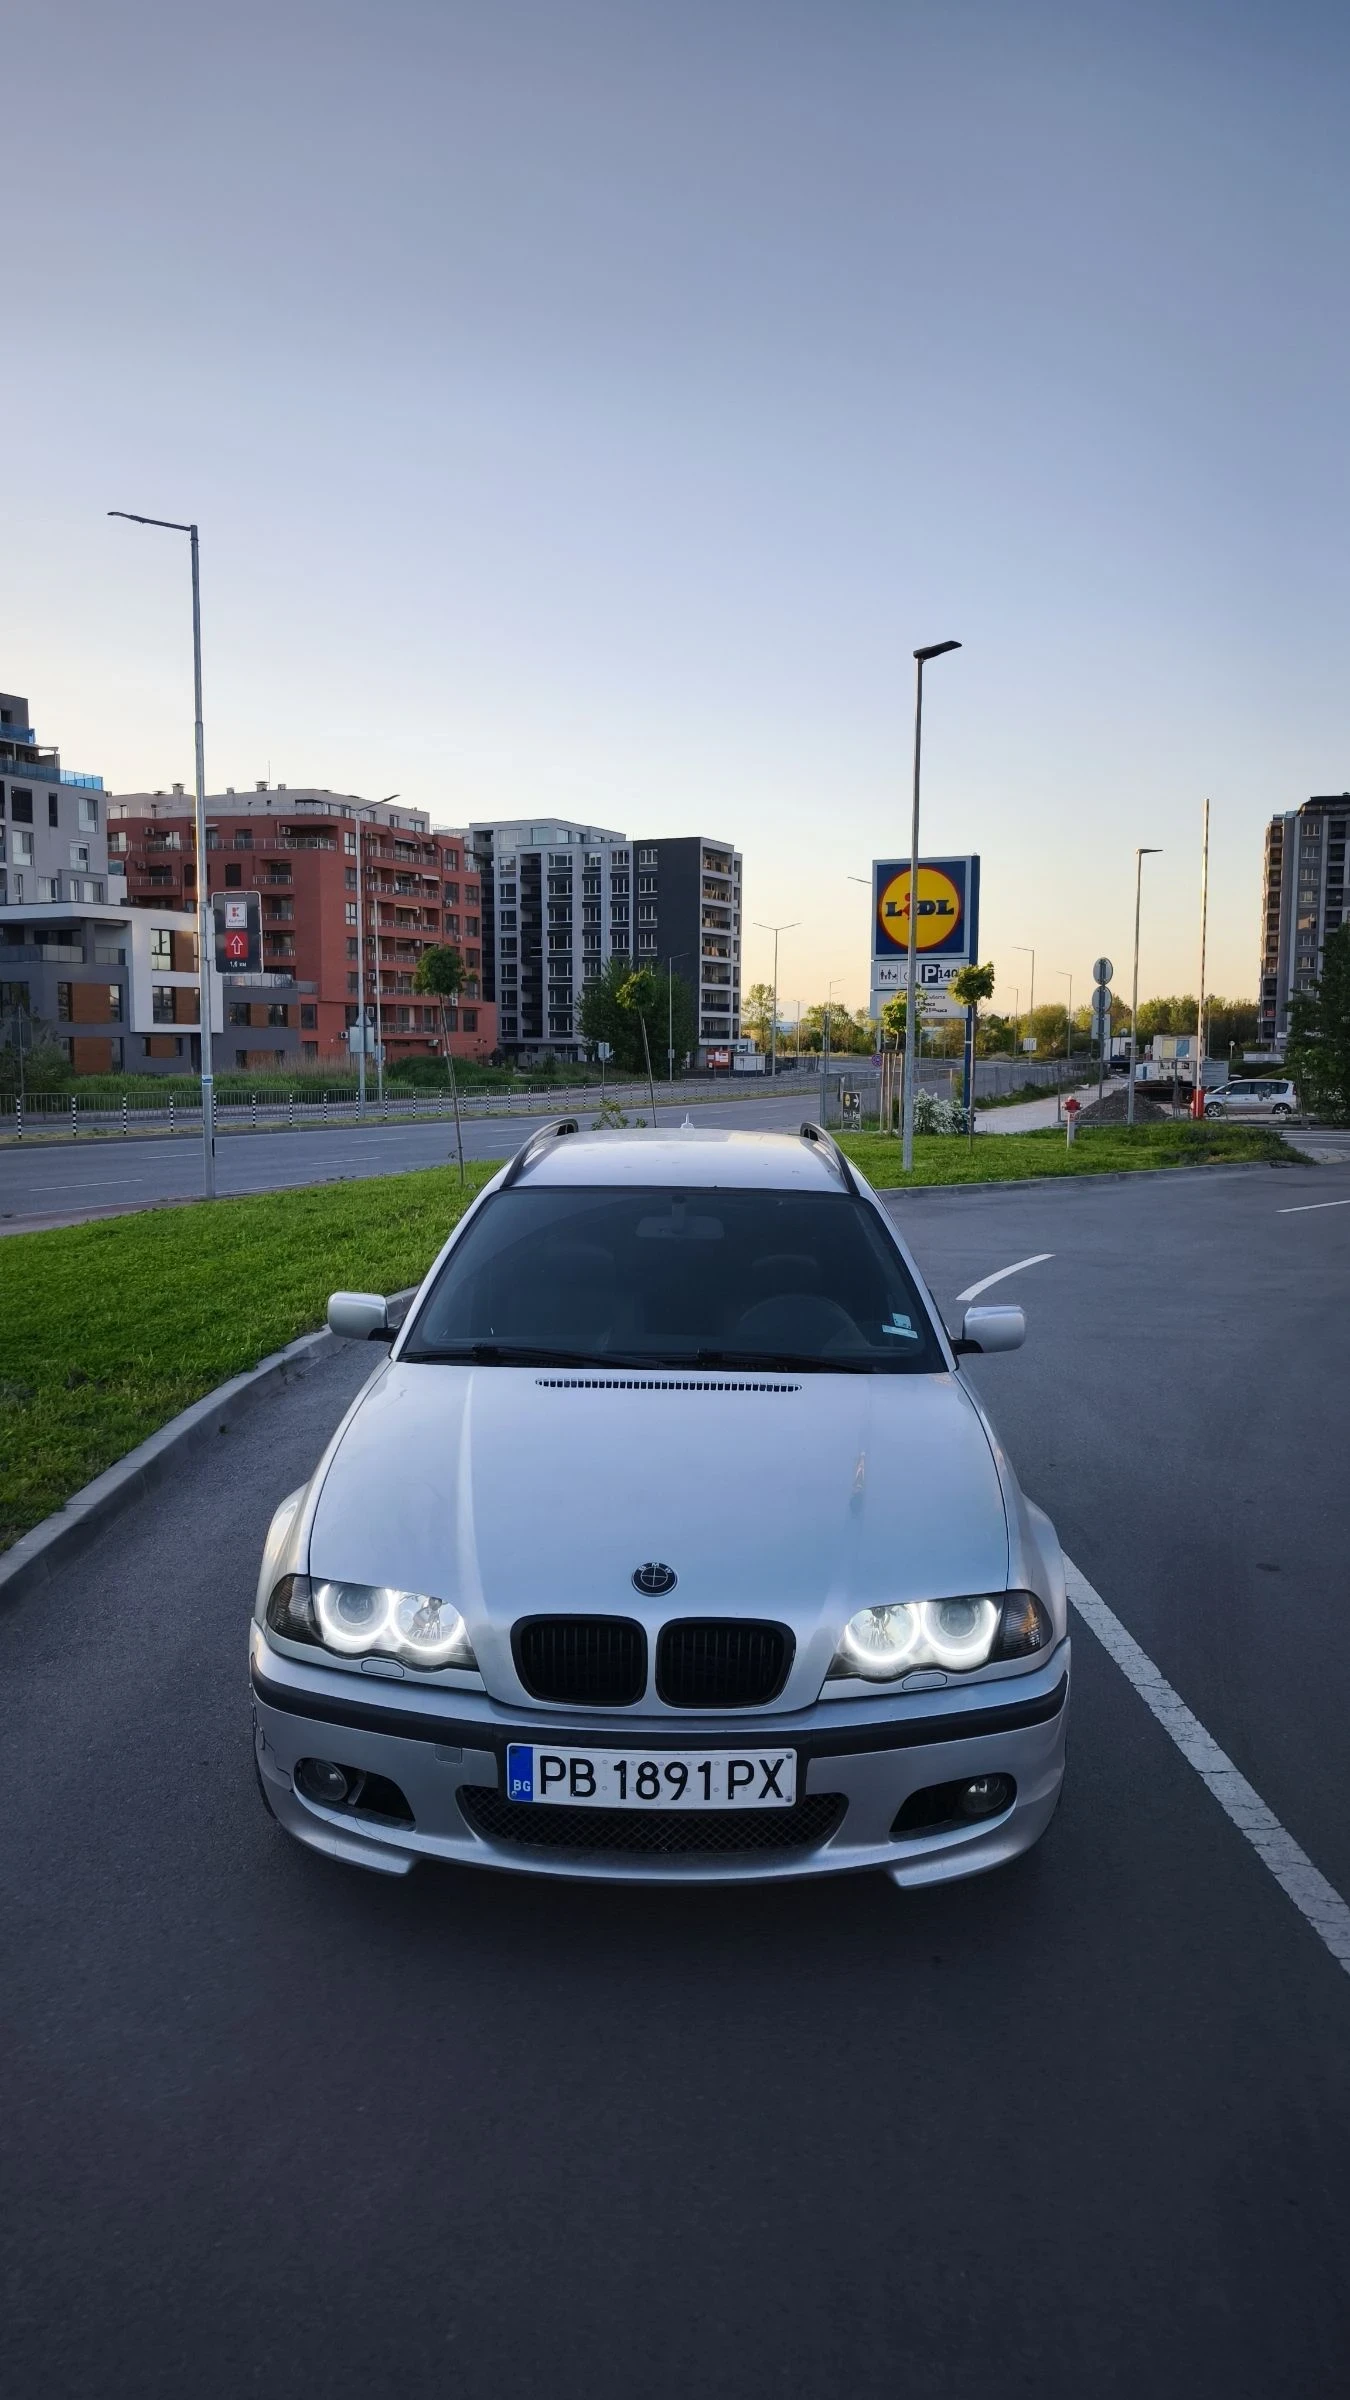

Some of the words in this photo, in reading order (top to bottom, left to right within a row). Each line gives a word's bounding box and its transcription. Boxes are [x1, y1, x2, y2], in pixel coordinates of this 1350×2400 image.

[924, 966, 937, 982] P
[513, 1779, 531, 1792] BG
[540, 1755, 597, 1798] PB
[613, 1759, 712, 1801] 1891
[727, 1758, 785, 1800] PX
